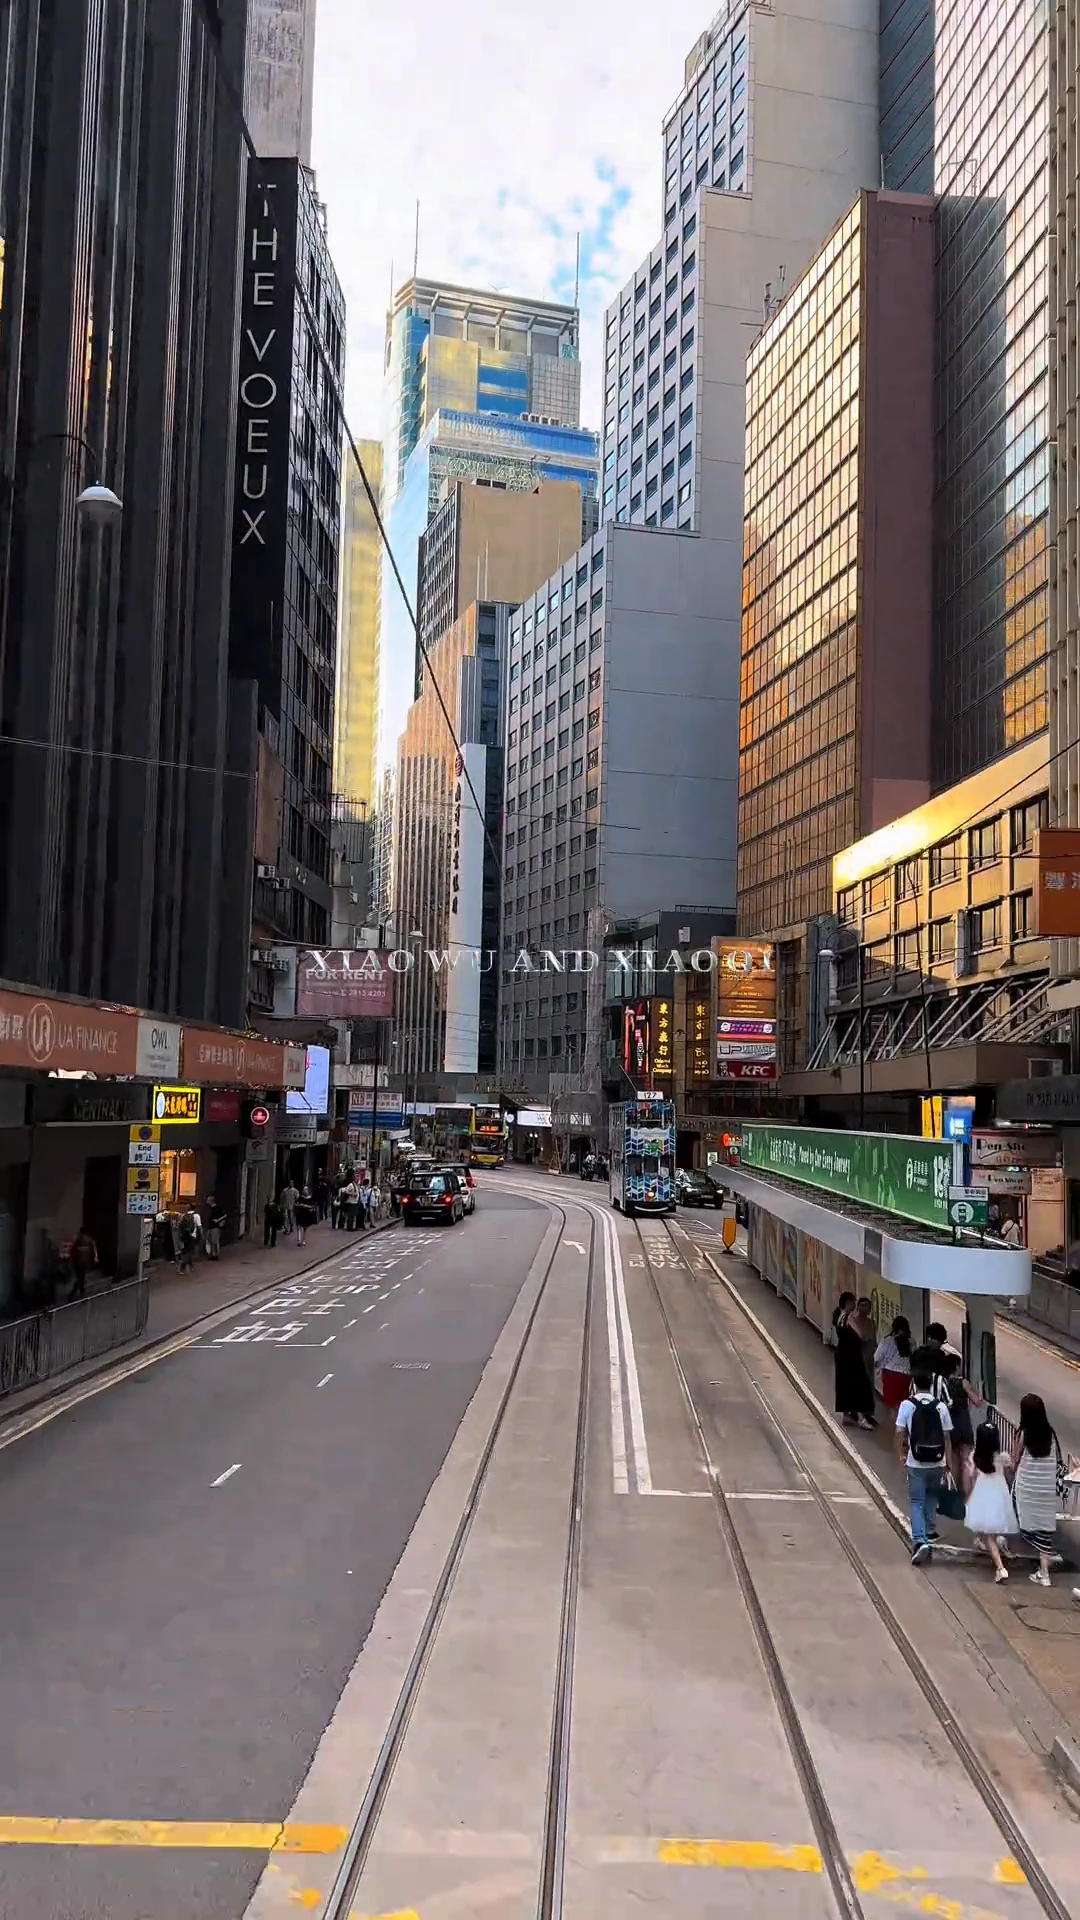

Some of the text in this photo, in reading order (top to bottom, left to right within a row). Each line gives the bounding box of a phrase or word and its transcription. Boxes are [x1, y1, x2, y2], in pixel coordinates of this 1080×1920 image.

[240, 183, 278, 546] THE VOEUX
[305, 969, 385, 981] FOR RENT
[76, 1026, 118, 1055] FINANCE
[740, 1065, 770, 1076] KFC
[277, 1284, 381, 1295] STOP
[249, 1298, 346, 1315] 巴士
